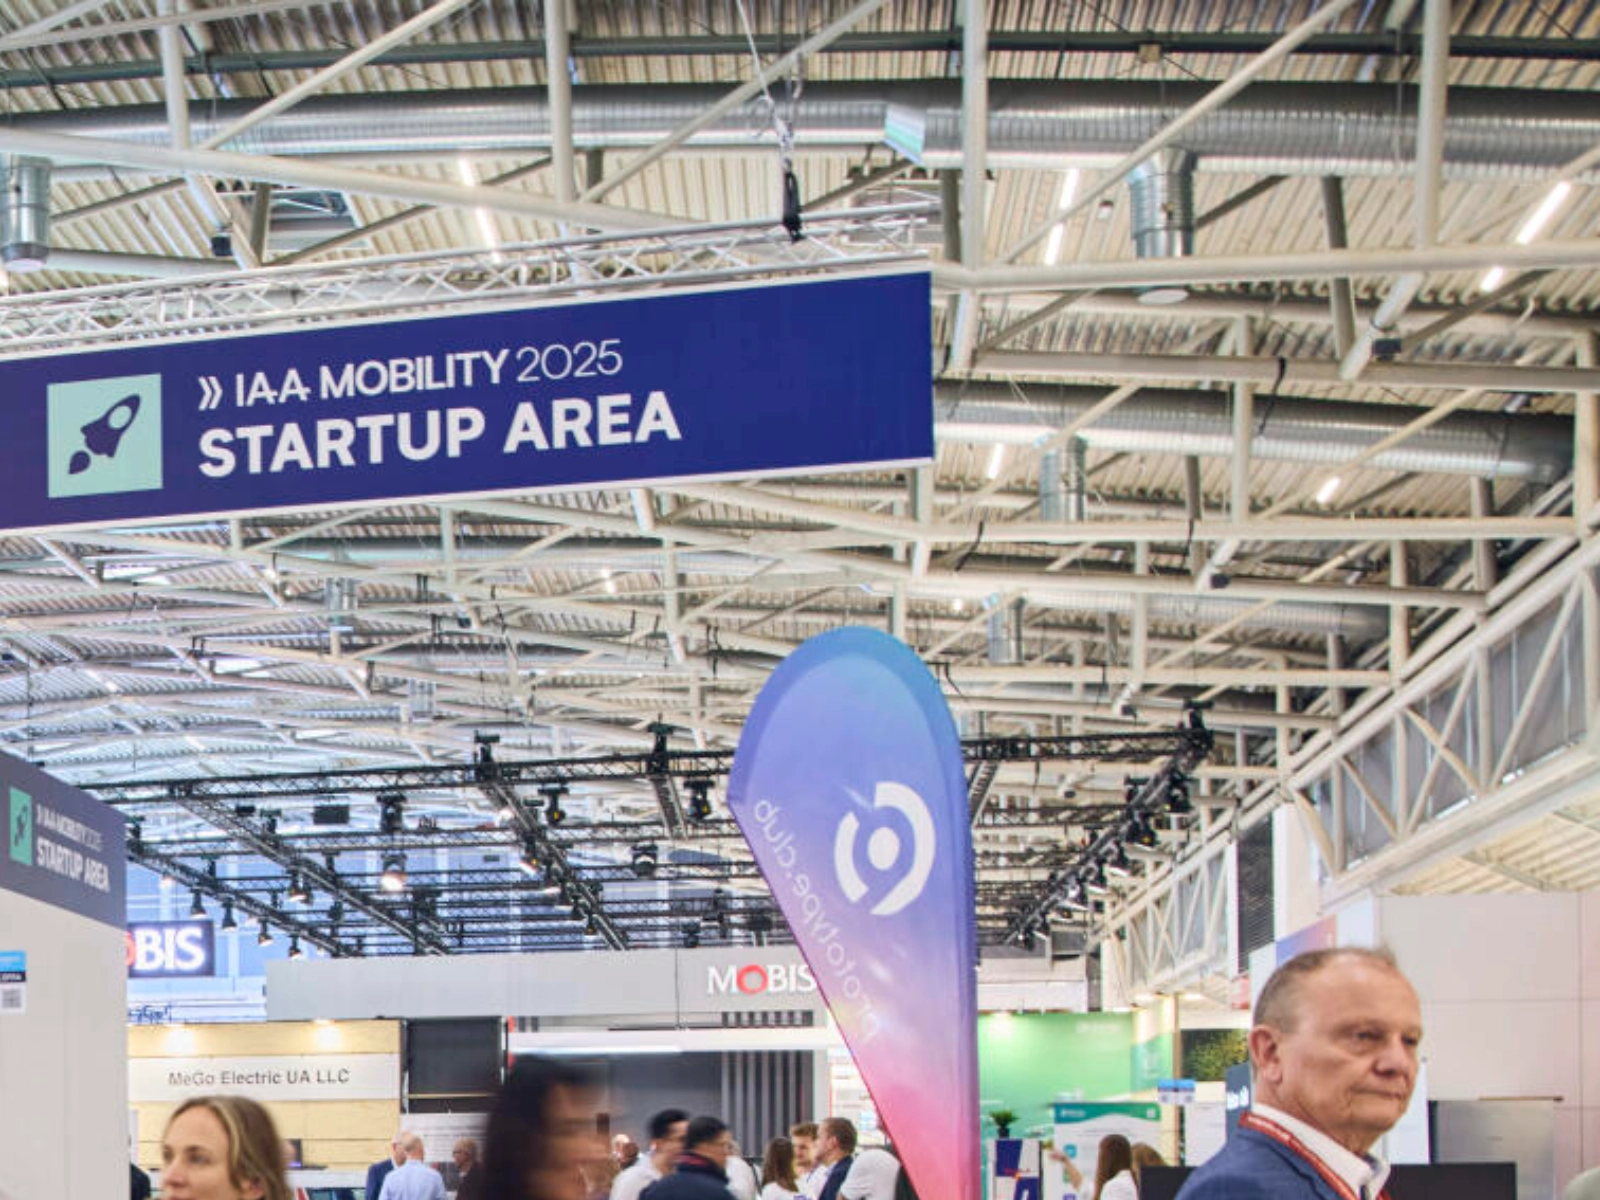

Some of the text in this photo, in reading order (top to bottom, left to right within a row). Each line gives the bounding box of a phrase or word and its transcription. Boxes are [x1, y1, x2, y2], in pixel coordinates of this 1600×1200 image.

[236, 338, 623, 407] IAA MOBILITY 2025
[199, 390, 682, 478] STARTUP AREA
[36, 836, 110, 893] STARTUP AREA
[706, 963, 817, 995] MOBIS
[168, 1068, 350, 1086] MeGo Electric UA LLC
